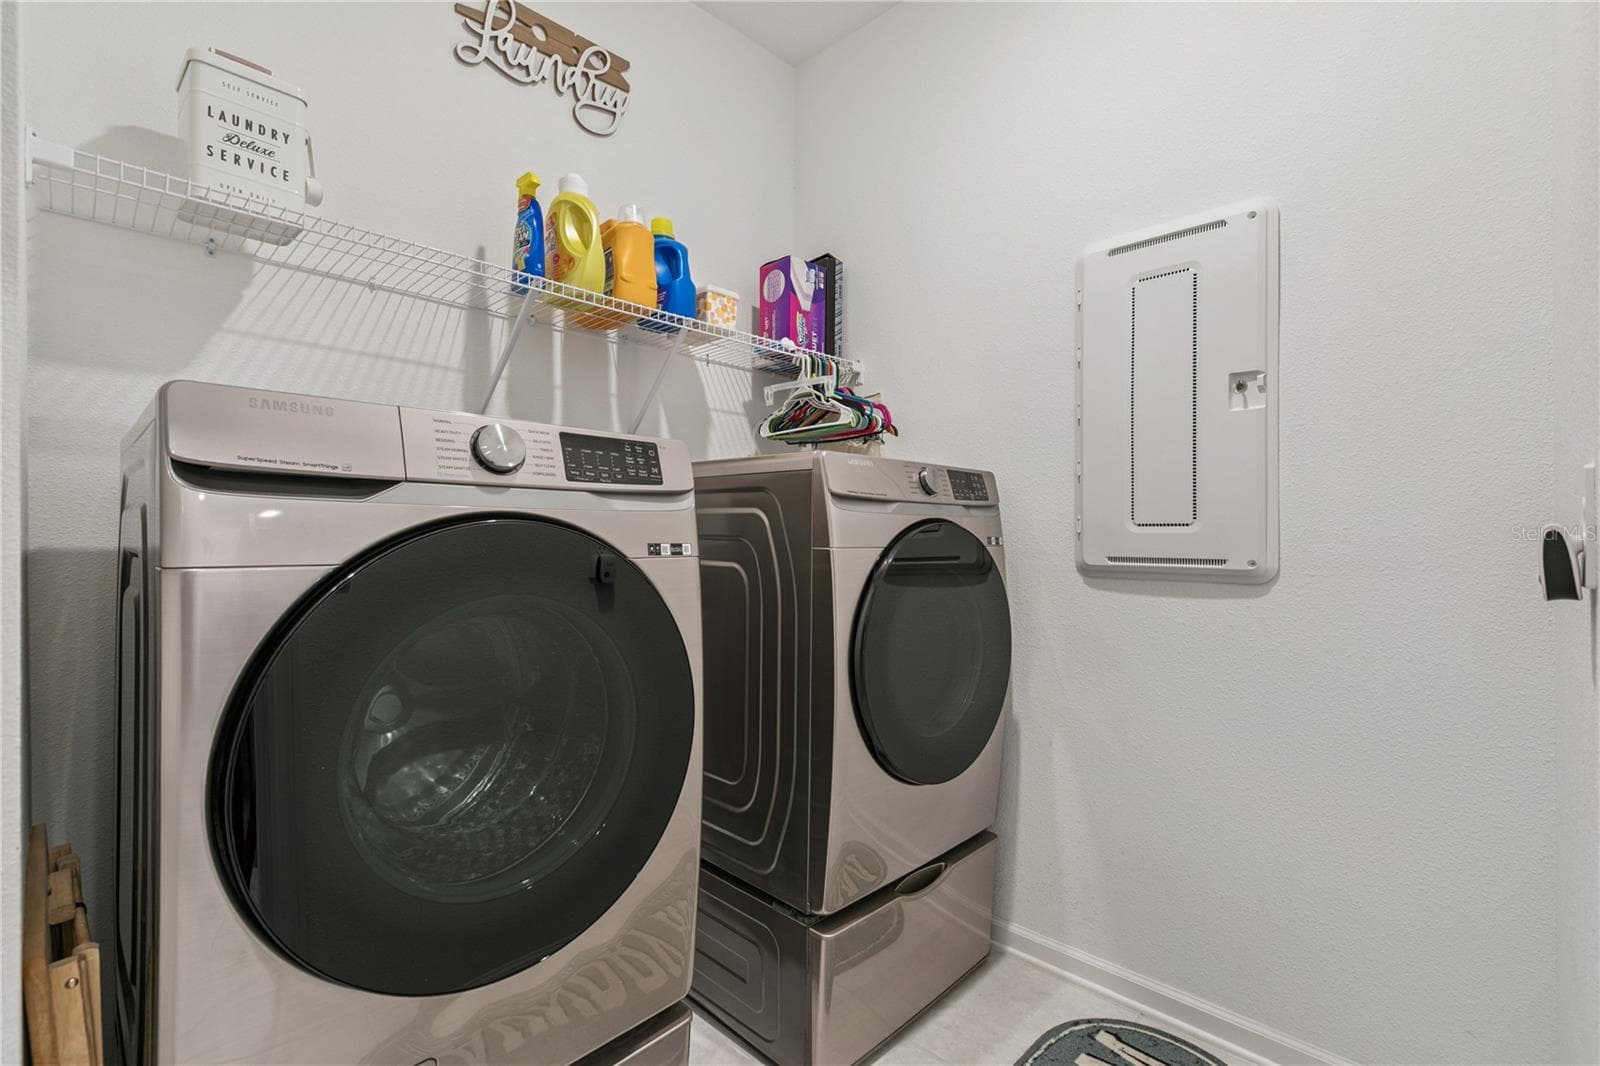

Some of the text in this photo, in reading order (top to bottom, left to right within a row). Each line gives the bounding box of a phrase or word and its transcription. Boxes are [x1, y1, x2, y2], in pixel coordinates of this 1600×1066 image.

[222, 81, 280, 108] SELF SERVICE
[207, 105, 291, 145] LAUNDRY
[222, 133, 276, 158] Deluxe
[206, 145, 290, 182] SERVICE
[248, 397, 335, 417] SAMSUNG
[237, 455, 278, 465] SuperSpeed
